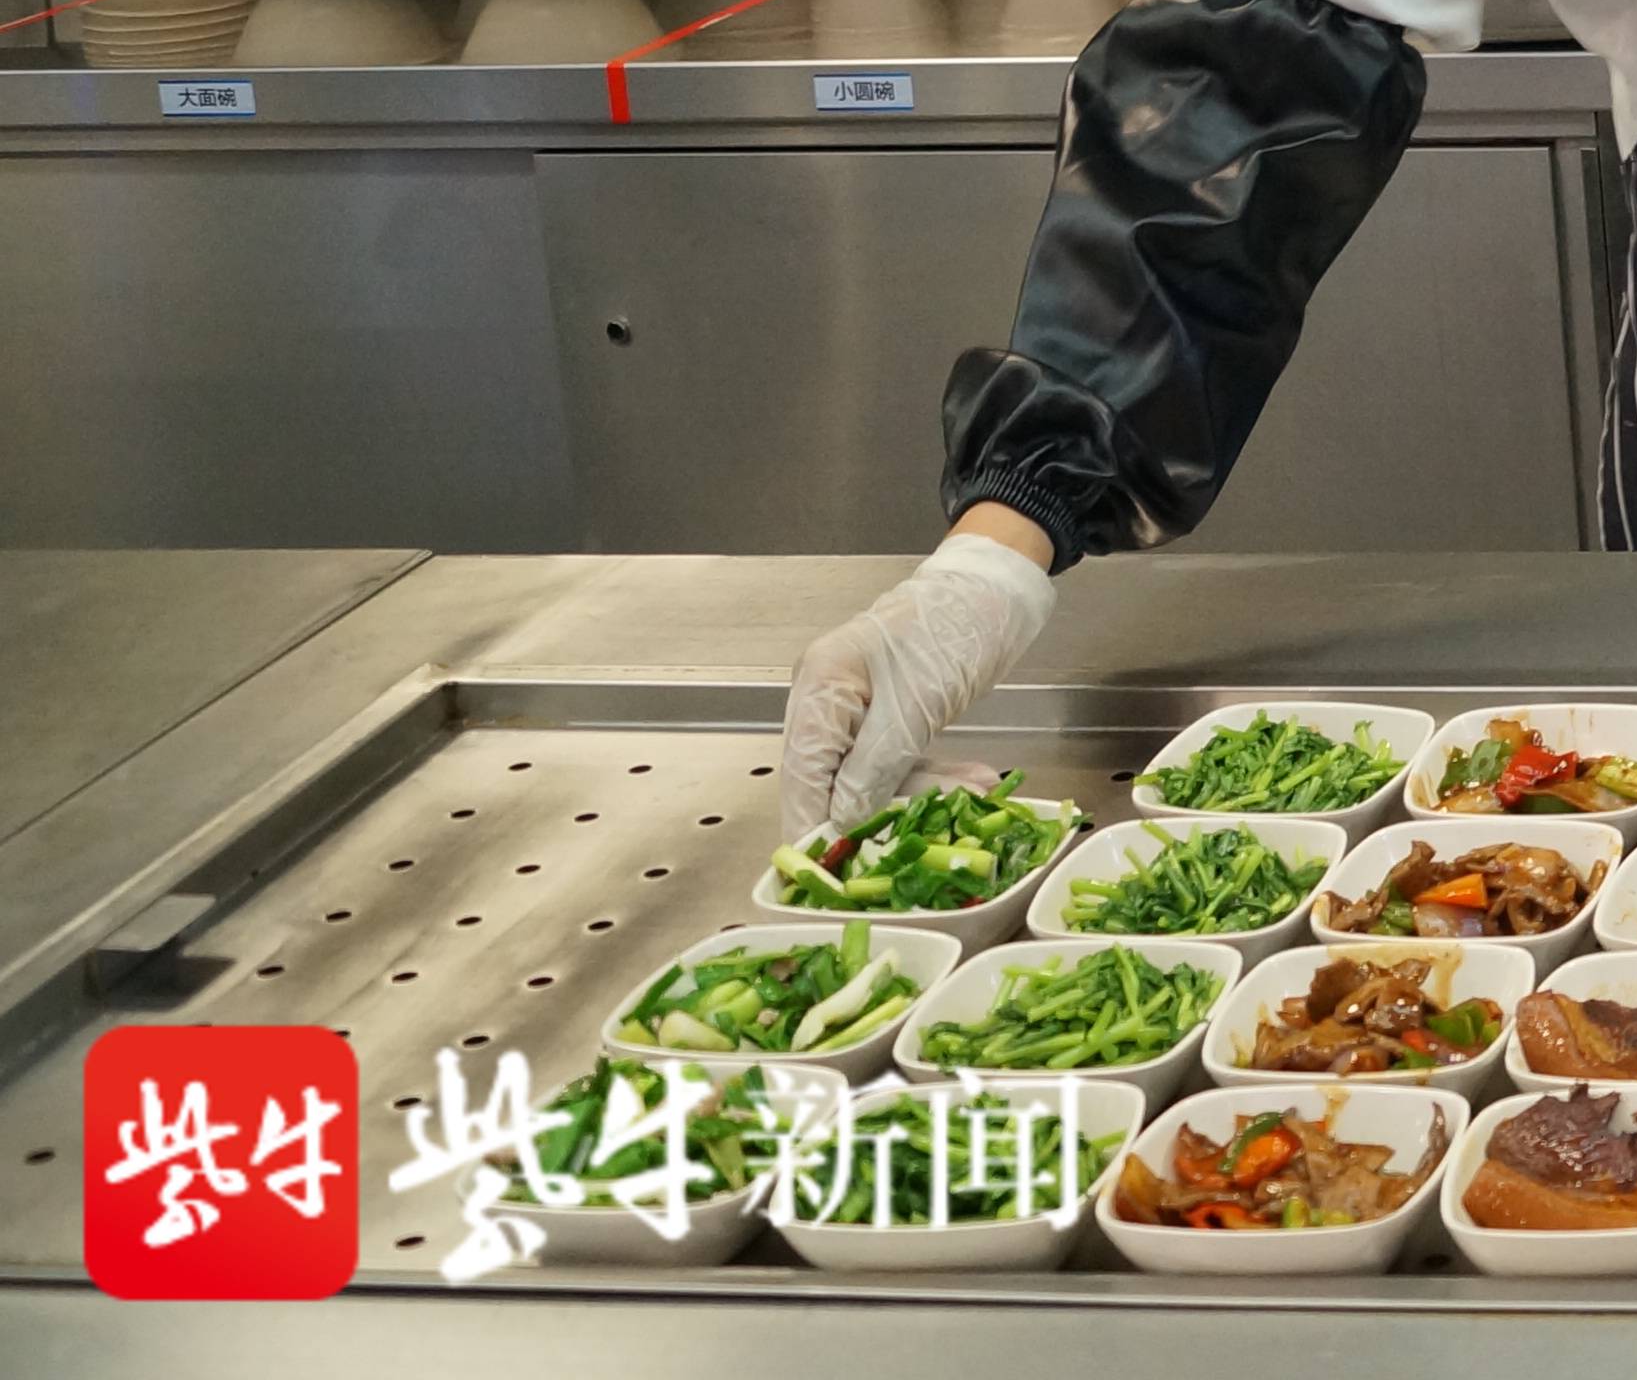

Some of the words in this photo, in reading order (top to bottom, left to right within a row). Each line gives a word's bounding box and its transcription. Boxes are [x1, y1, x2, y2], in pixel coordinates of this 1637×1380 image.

[177, 86, 237, 107] 大面碗
[834, 81, 896, 102] 小圆碗
